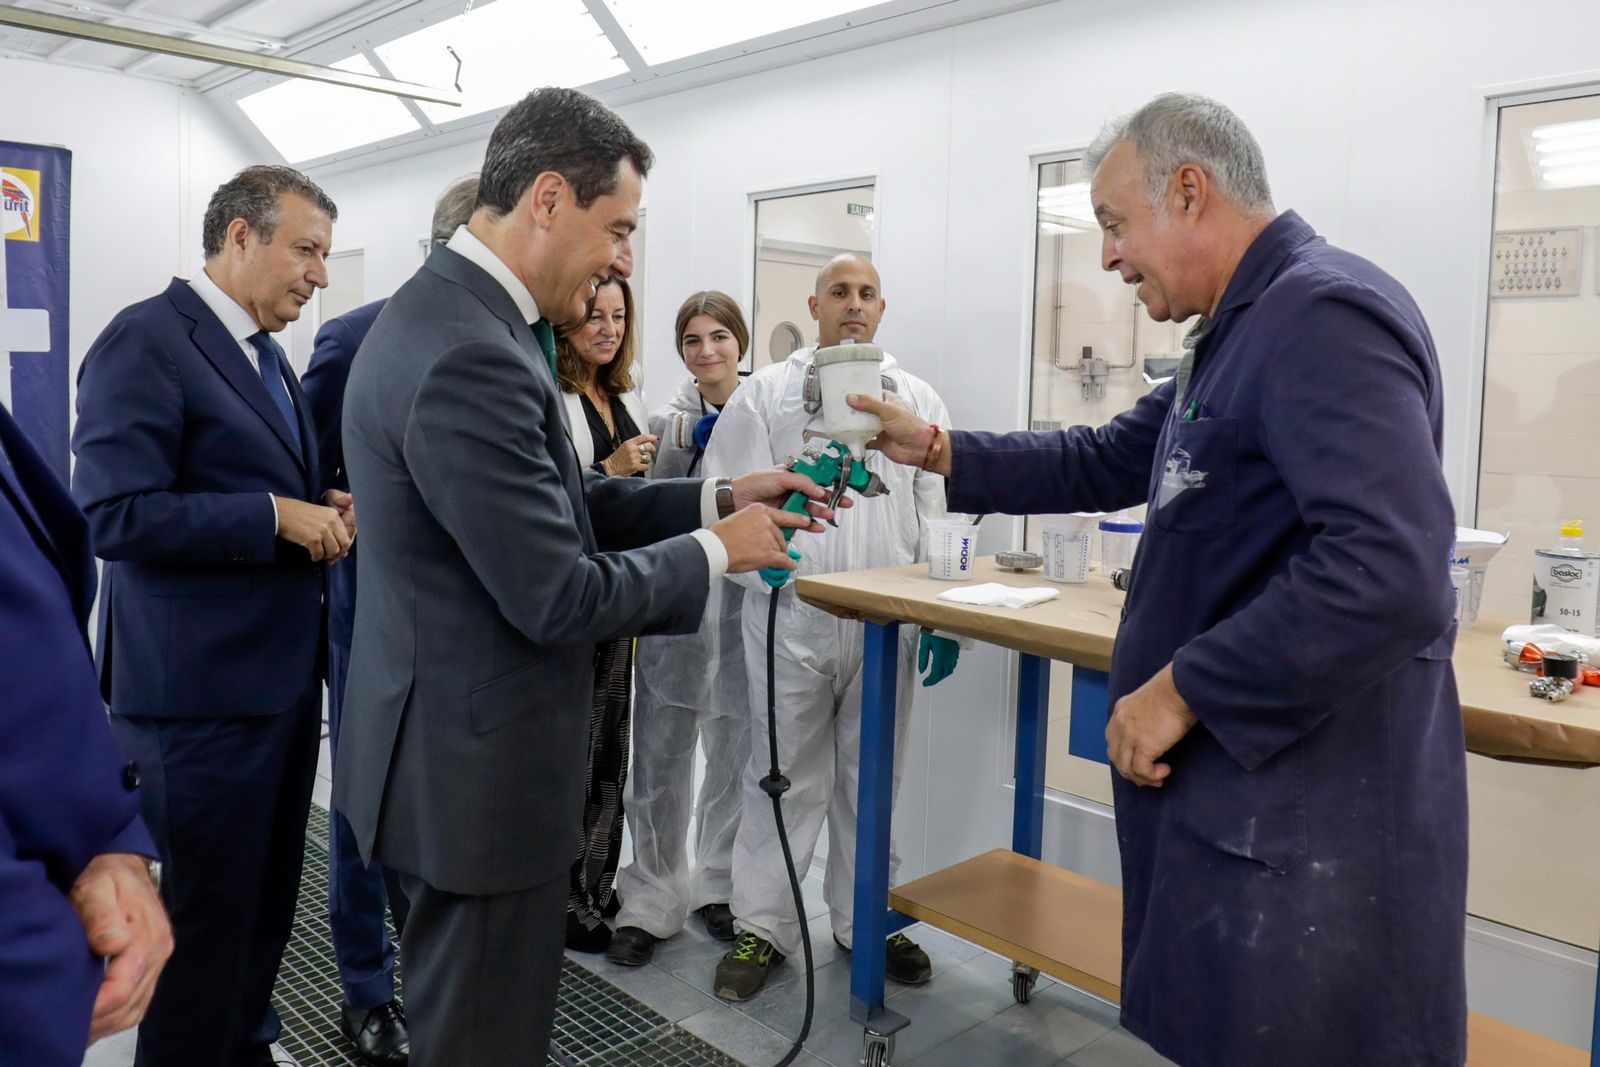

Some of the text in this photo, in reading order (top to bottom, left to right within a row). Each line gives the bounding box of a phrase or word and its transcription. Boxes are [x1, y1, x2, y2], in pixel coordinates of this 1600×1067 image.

[959, 536, 970, 571] RODIM
[1553, 568, 1580, 579] baslac
[1559, 607, 1581, 617] 50-15
